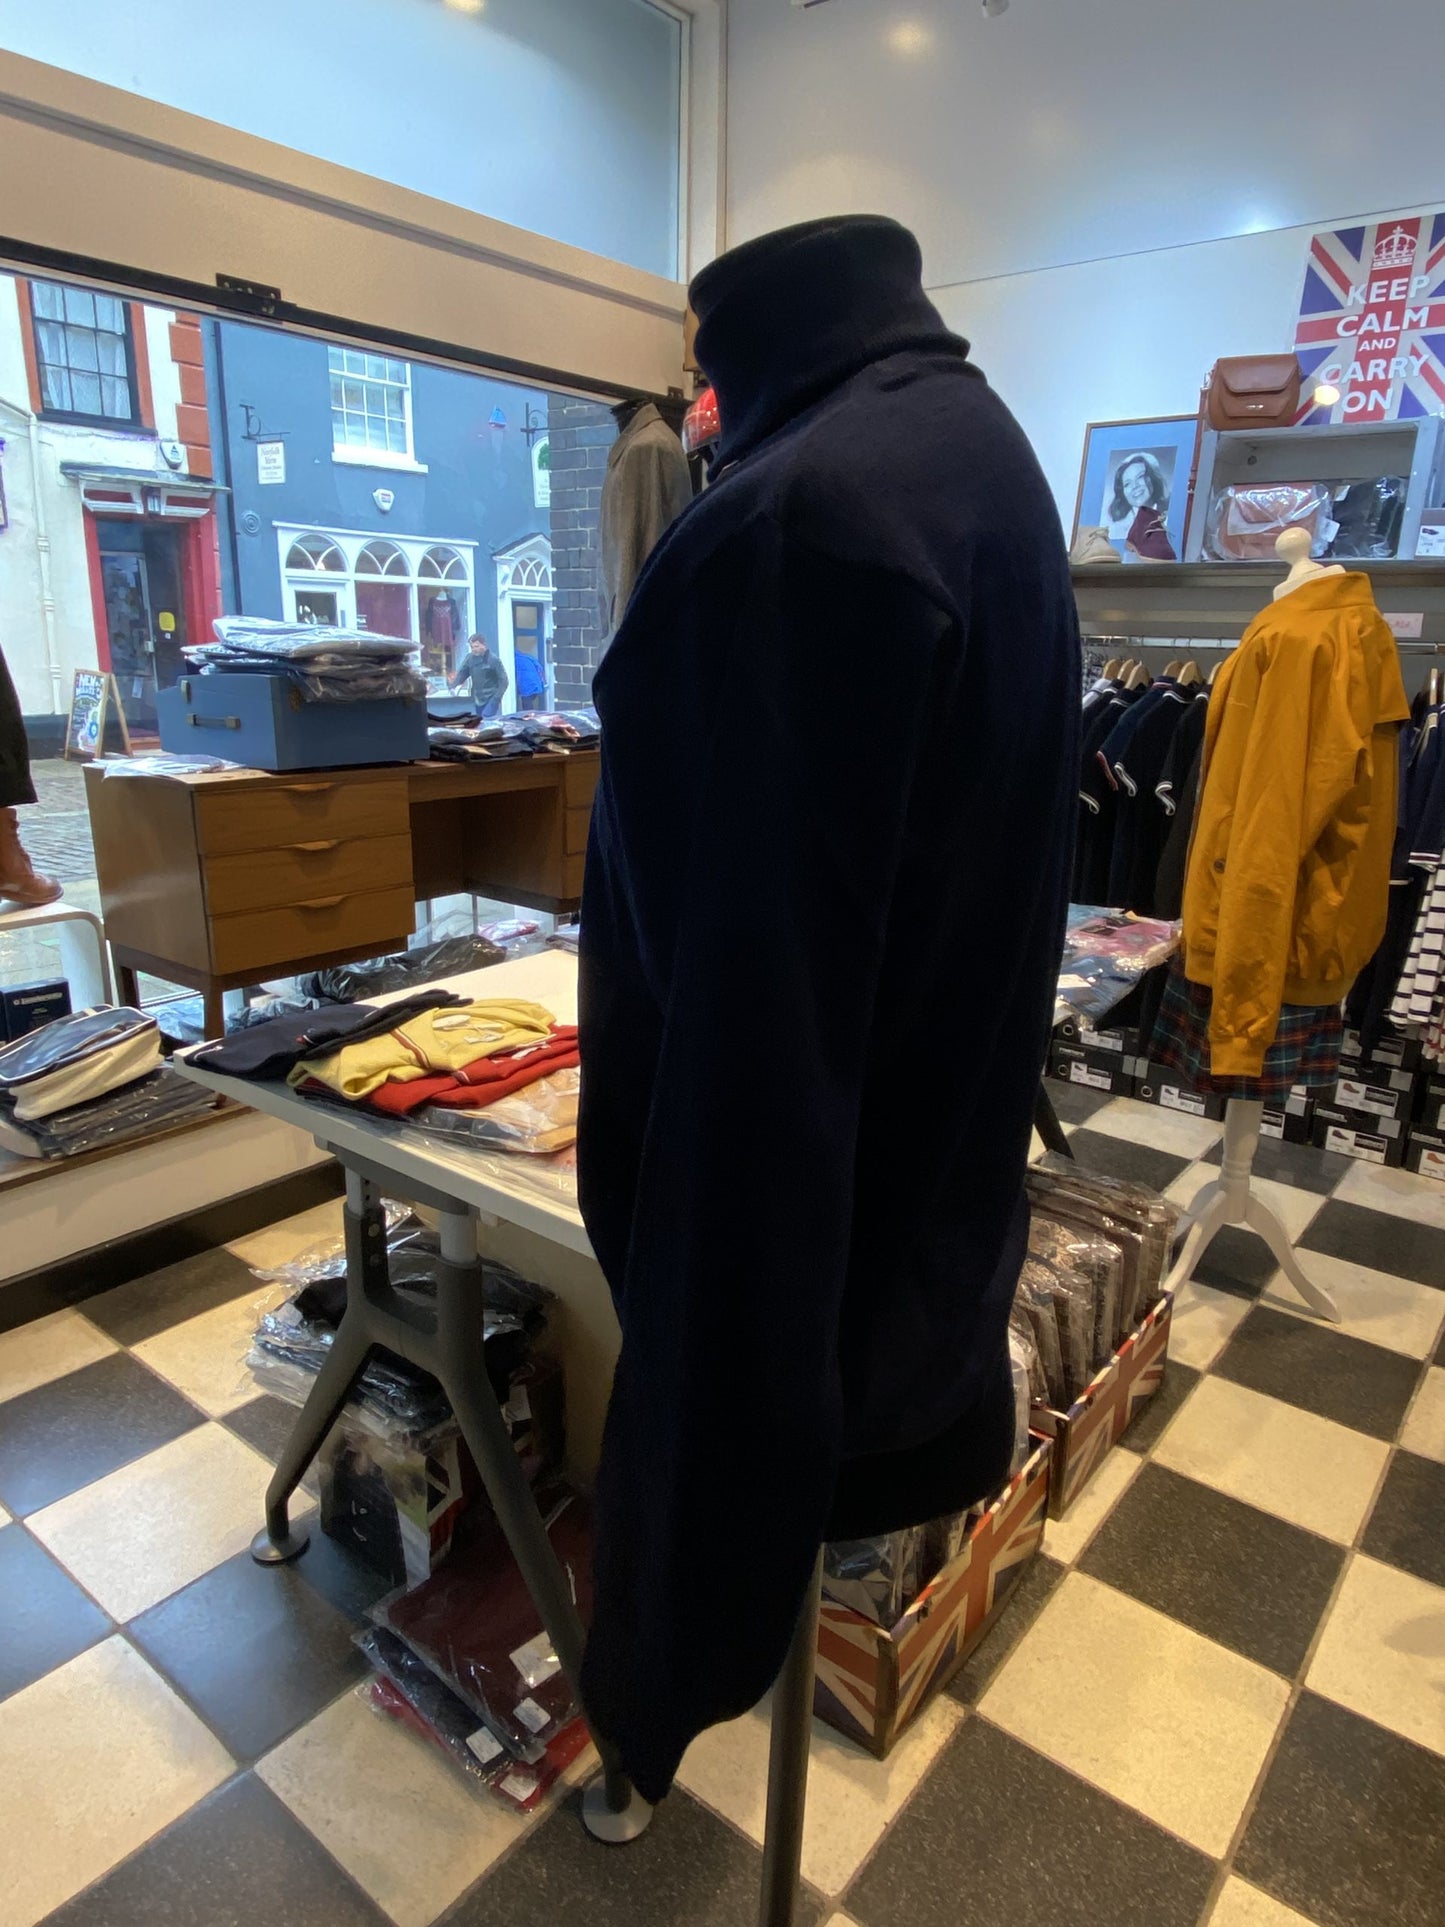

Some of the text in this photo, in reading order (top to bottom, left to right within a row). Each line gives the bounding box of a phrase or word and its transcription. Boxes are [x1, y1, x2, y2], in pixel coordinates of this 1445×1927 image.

[1346, 275, 1430, 306] KEEP
[1336, 306, 1430, 337] CALM
[1359, 337, 1396, 352] AND
[1319, 354, 1430, 385] CARRY
[1341, 387, 1393, 413] ON
